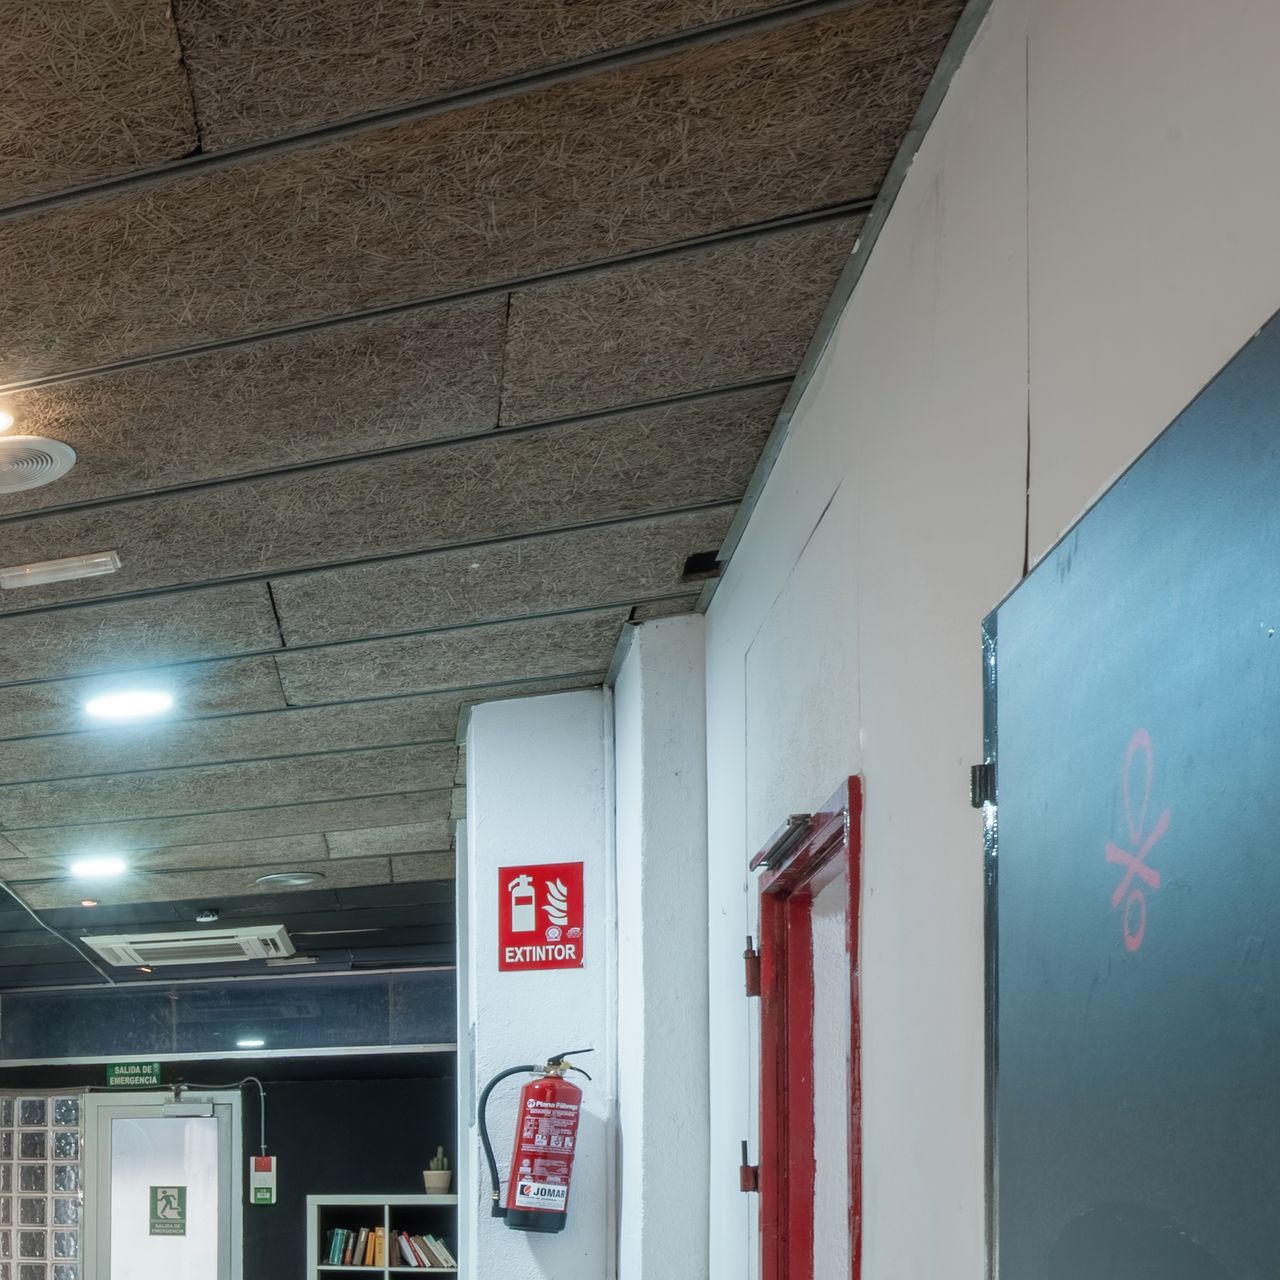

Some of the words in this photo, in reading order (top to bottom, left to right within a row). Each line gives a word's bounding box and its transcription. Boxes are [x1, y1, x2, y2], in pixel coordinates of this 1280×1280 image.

[505, 944, 577, 963] EXTINTOR
[114, 1065, 141, 1074] SALIDA
[142, 1065, 153, 1074] DE
[110, 1076, 158, 1085] EMERGENCIA
[533, 1187, 566, 1199] JOMAR
